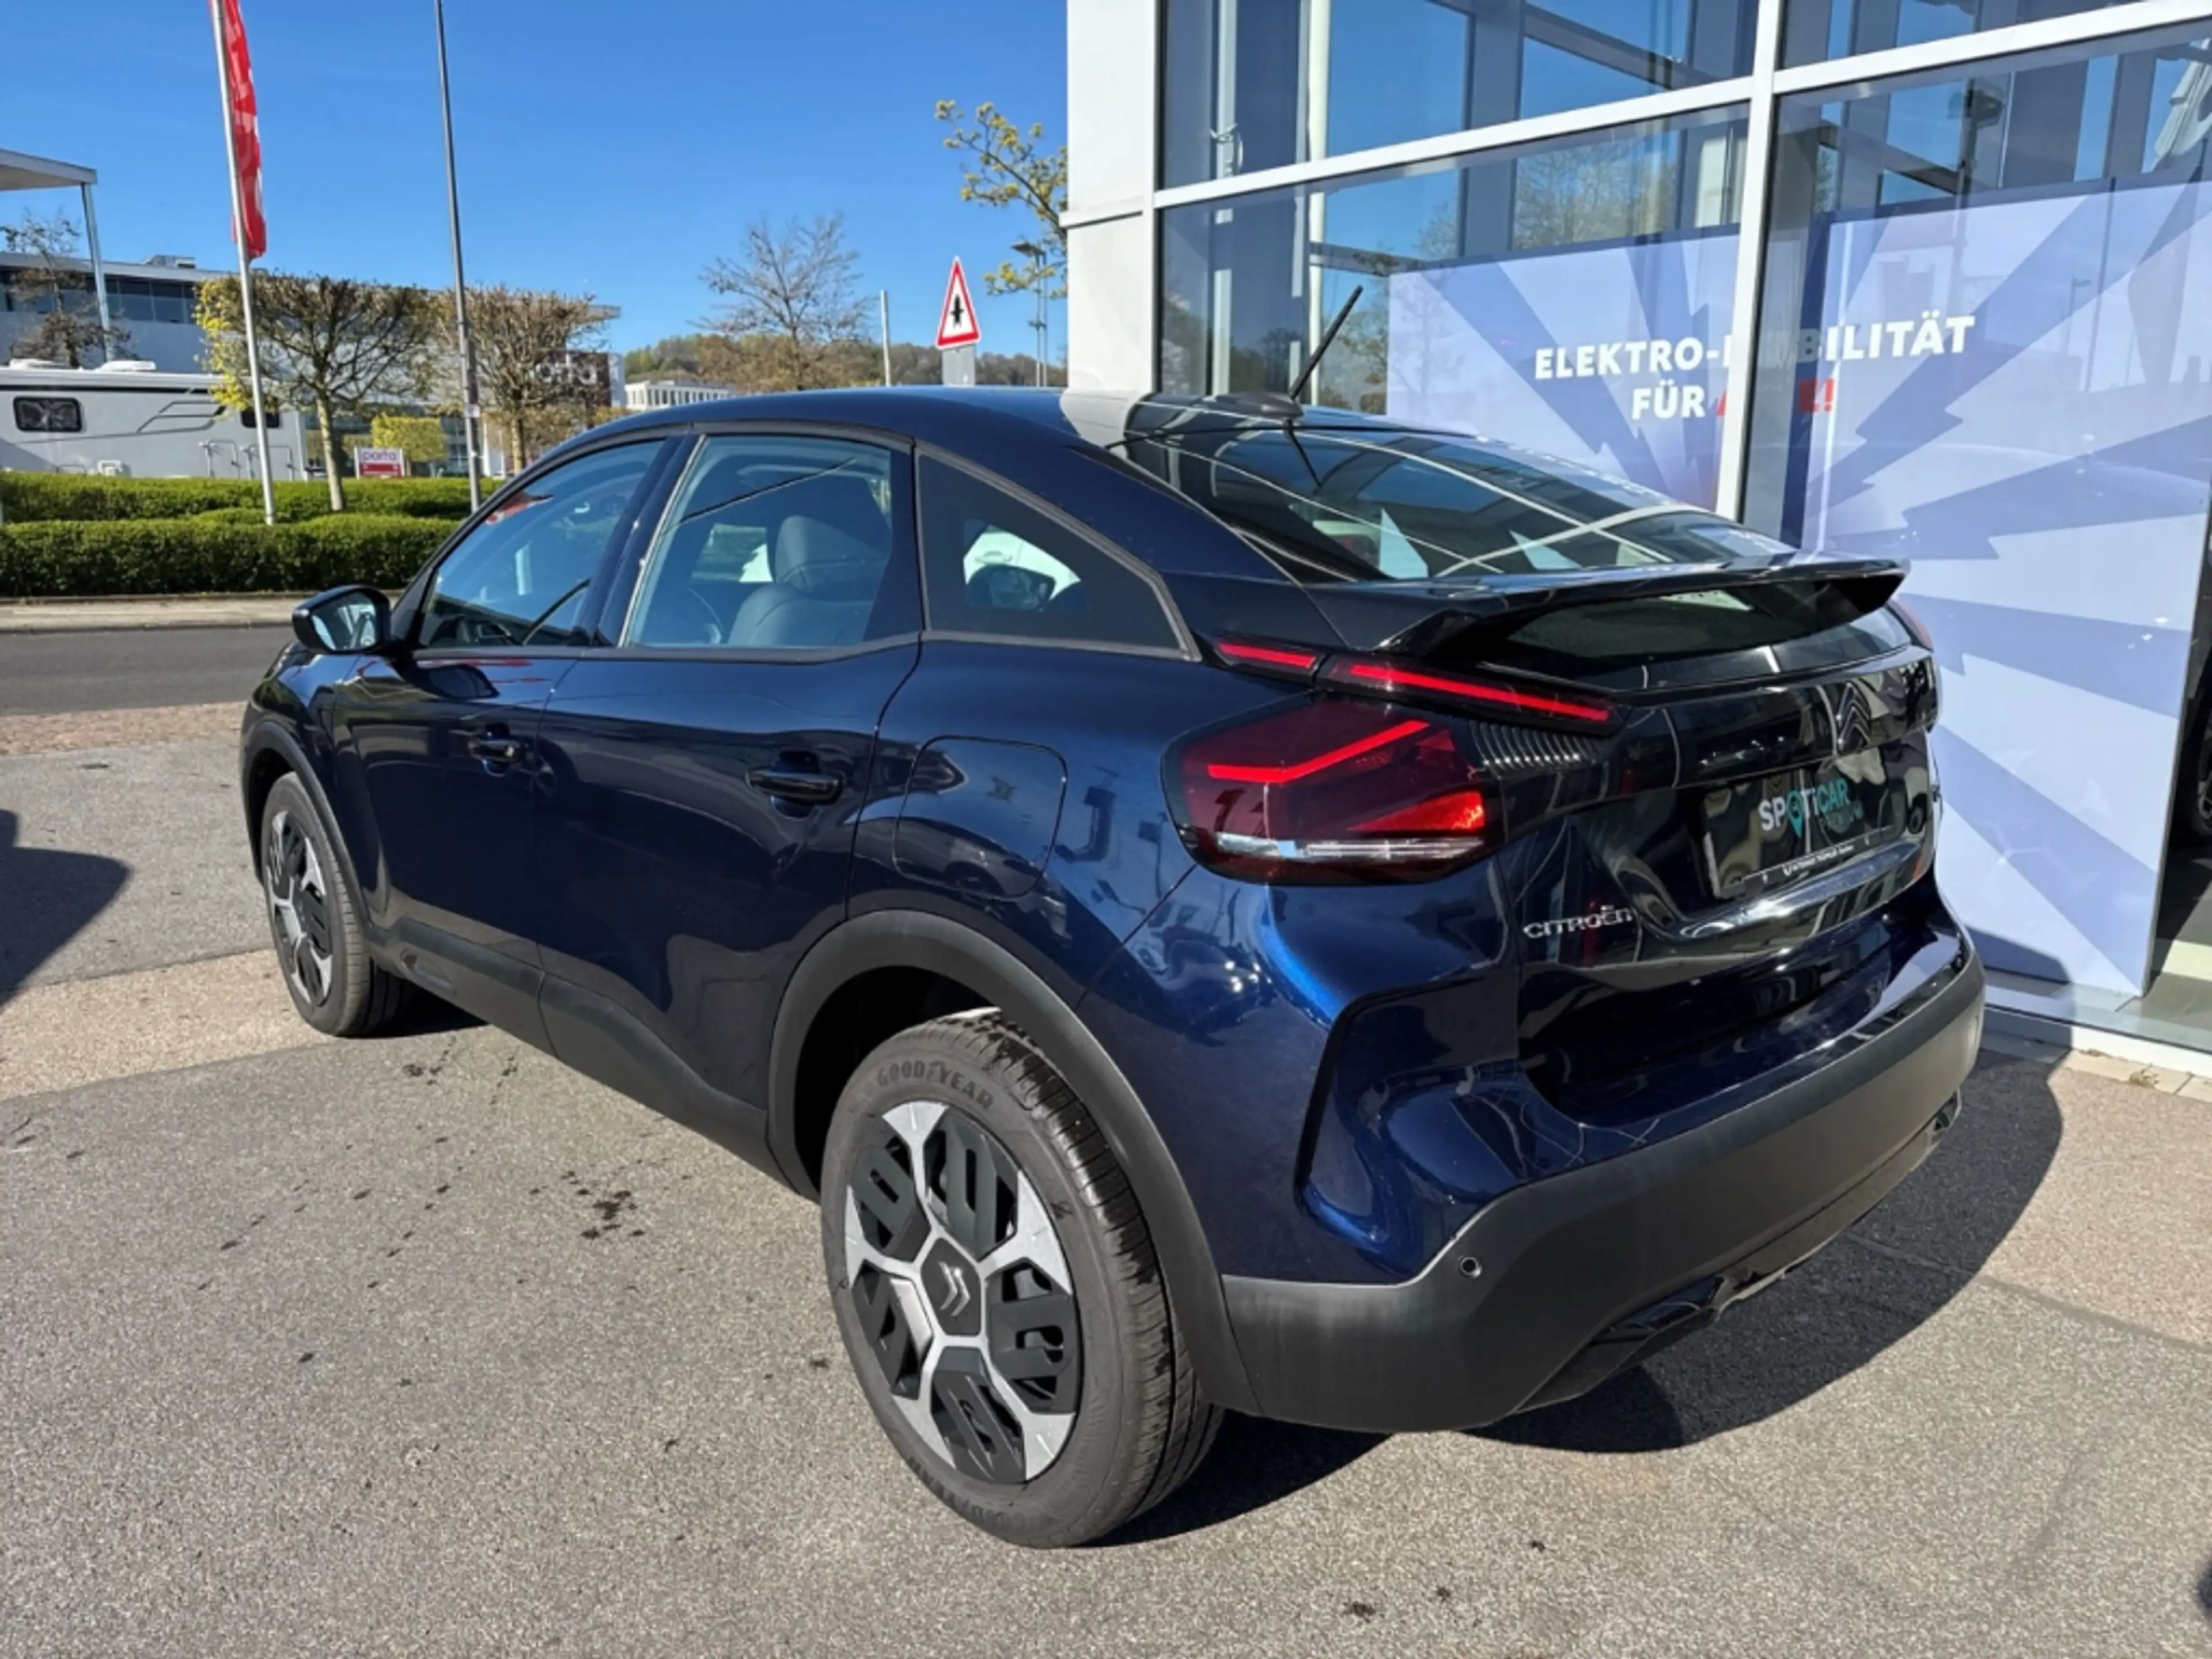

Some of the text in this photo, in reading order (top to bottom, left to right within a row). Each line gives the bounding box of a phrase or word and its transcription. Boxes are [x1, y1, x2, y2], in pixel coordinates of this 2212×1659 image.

[1535, 309, 1975, 380] ELEKTRO-BILITÄT
[1631, 378, 1706, 420] FÜR
[877, 1060, 994, 1110] GOODYEAR
